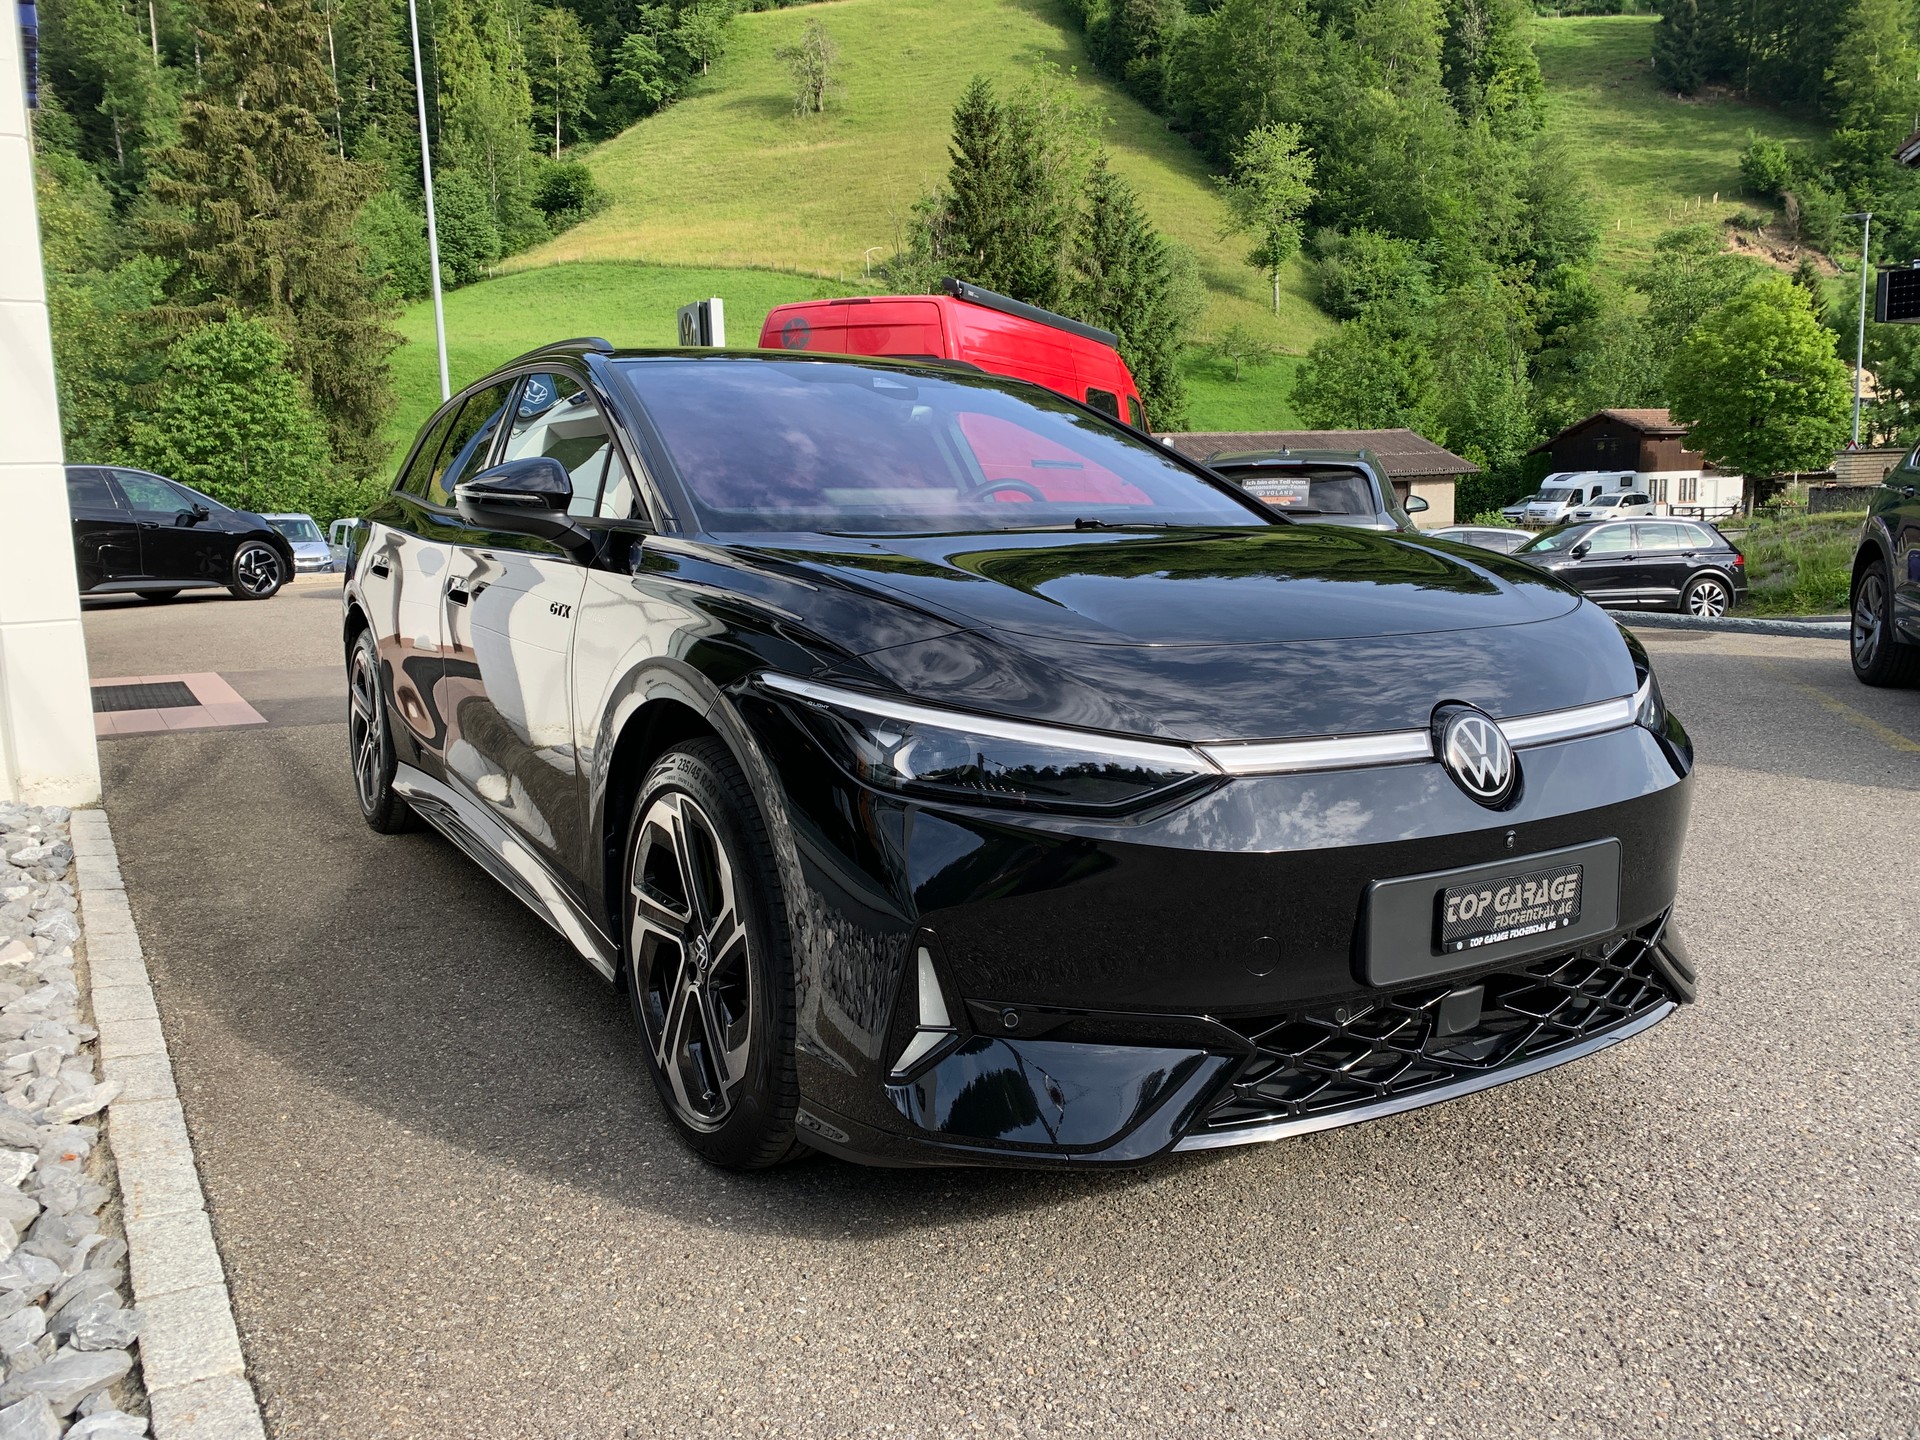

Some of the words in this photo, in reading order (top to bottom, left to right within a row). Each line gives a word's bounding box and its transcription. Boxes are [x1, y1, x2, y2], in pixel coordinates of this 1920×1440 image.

[550, 601, 572, 619] GTX
[677, 758, 701, 780] 235/45
[1447, 890, 1492, 923] TOP
[1494, 873, 1578, 913] GARAGE
[1493, 905, 1556, 929] FISCHENTHAL
[1558, 901, 1573, 915] AG
[1470, 936, 1483, 947] TOP
[1484, 931, 1510, 944] GARAGE
[1509, 922, 1547, 939] FISCHENTHAL
[1547, 920, 1557, 930] AG
